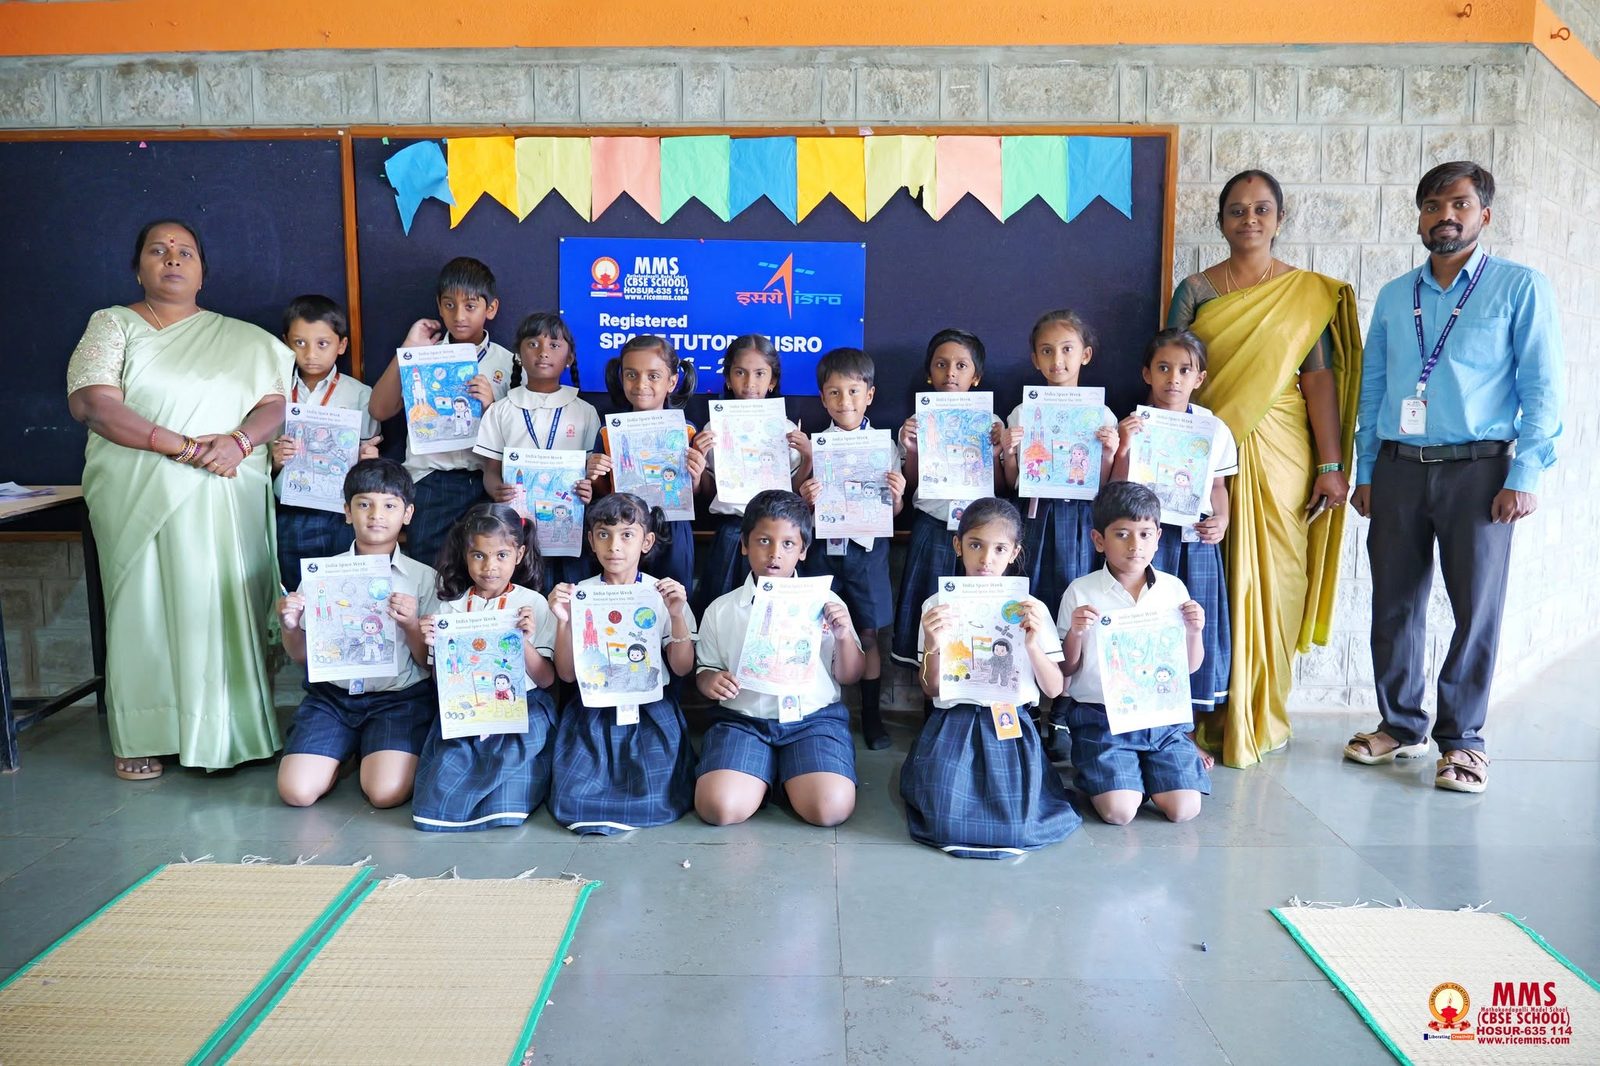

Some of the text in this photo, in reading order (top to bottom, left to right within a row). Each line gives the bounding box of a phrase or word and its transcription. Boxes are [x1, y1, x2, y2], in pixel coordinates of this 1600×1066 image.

[634, 256, 679, 274] MMS
[624, 277, 648, 288] (CBSE
[650, 278, 688, 289] SCHOOL)
[736, 289, 784, 306] इसरो
[600, 313, 688, 330] Registered
[774, 336, 822, 353] ISRO
